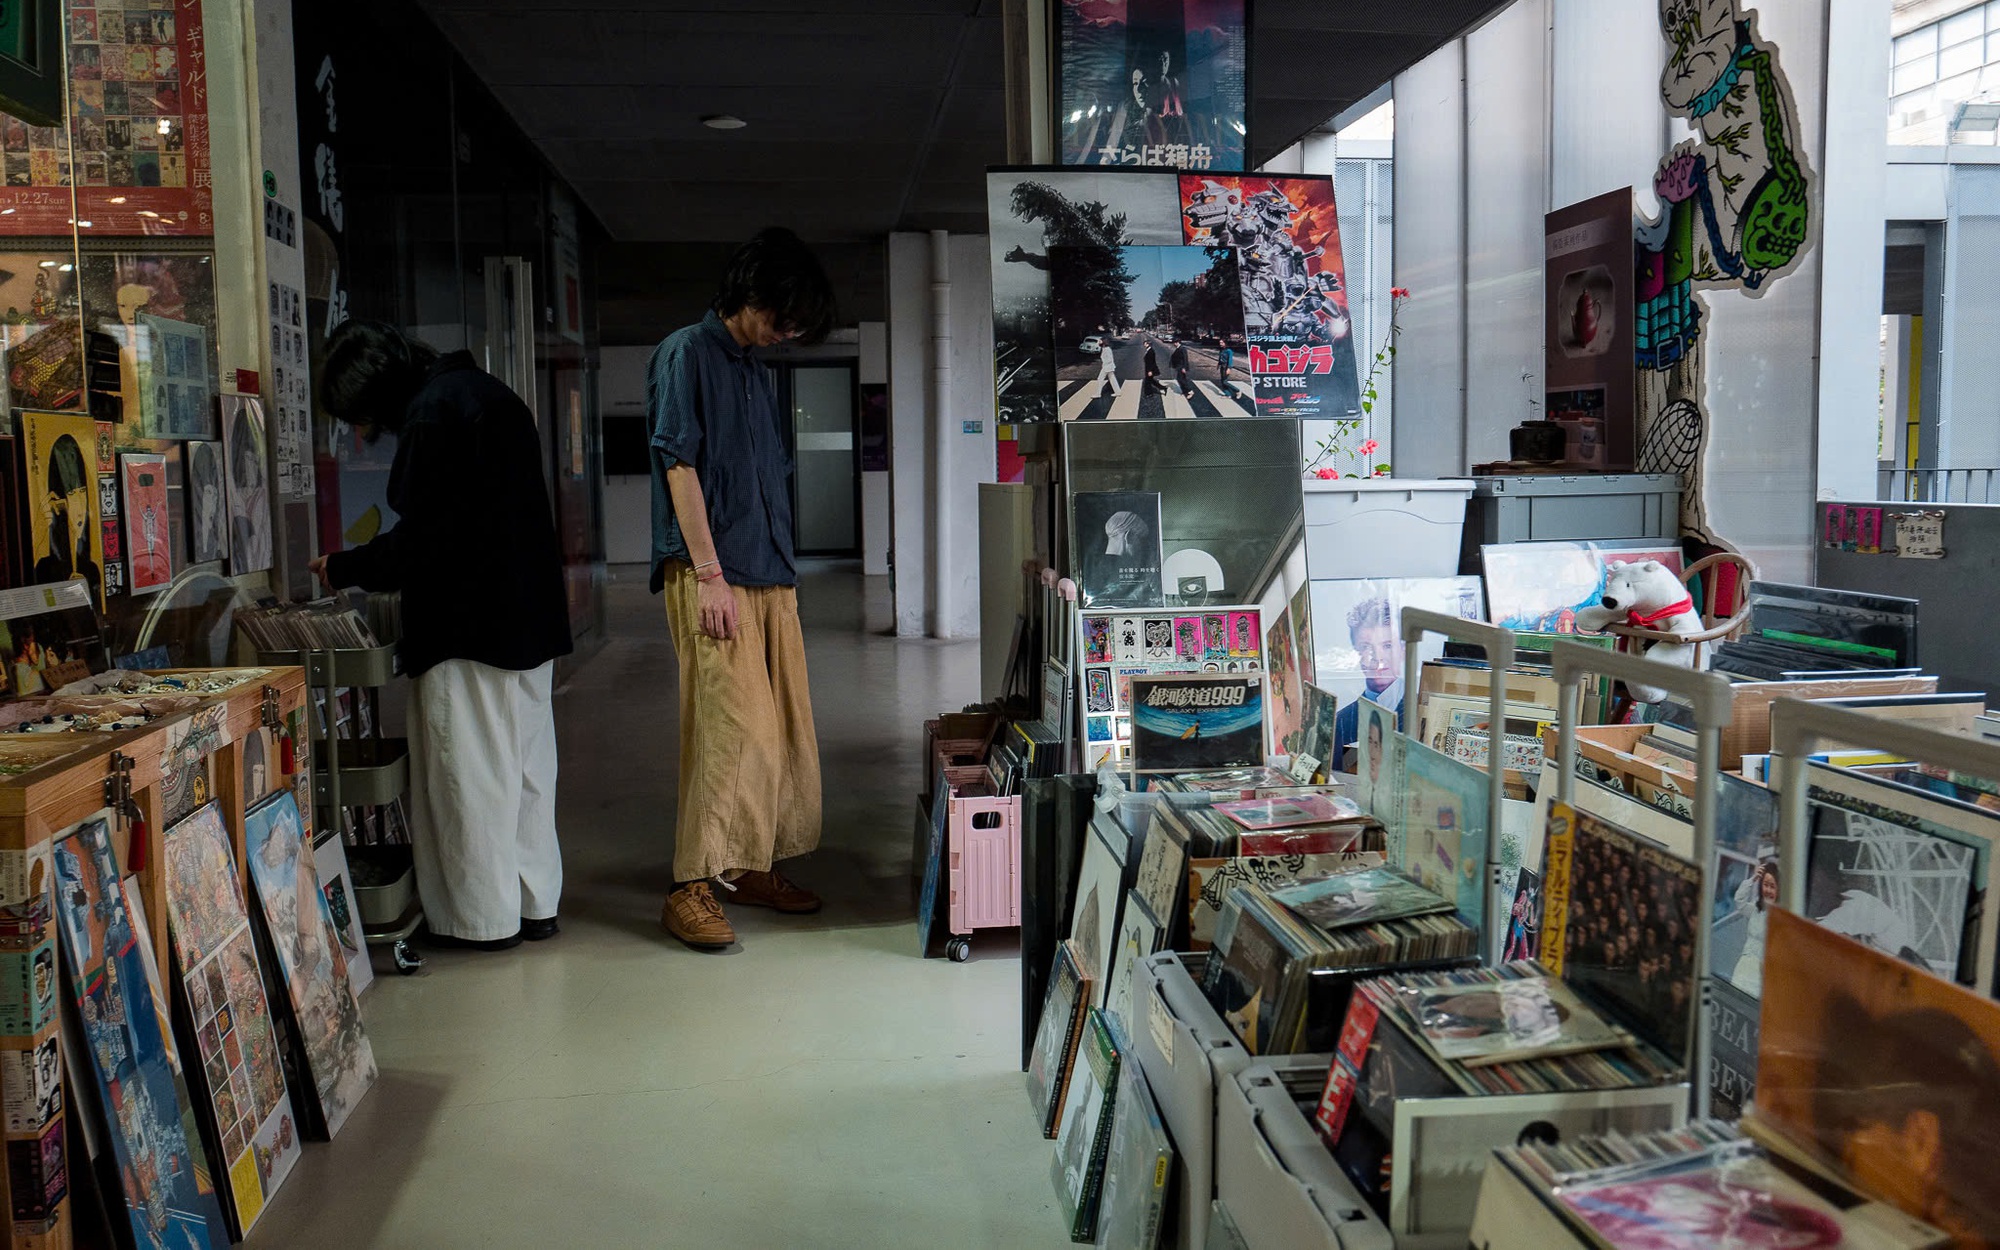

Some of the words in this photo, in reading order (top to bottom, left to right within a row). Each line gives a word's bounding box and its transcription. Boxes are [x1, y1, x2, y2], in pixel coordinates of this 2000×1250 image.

[1098, 142, 1214, 170] さらば箱舟
[192, 168, 212, 189] 展
[1263, 377, 1307, 388] STORE
[1142, 685, 1246, 708] 銀河鉄道999
[1710, 1000, 1759, 1058] BEA
